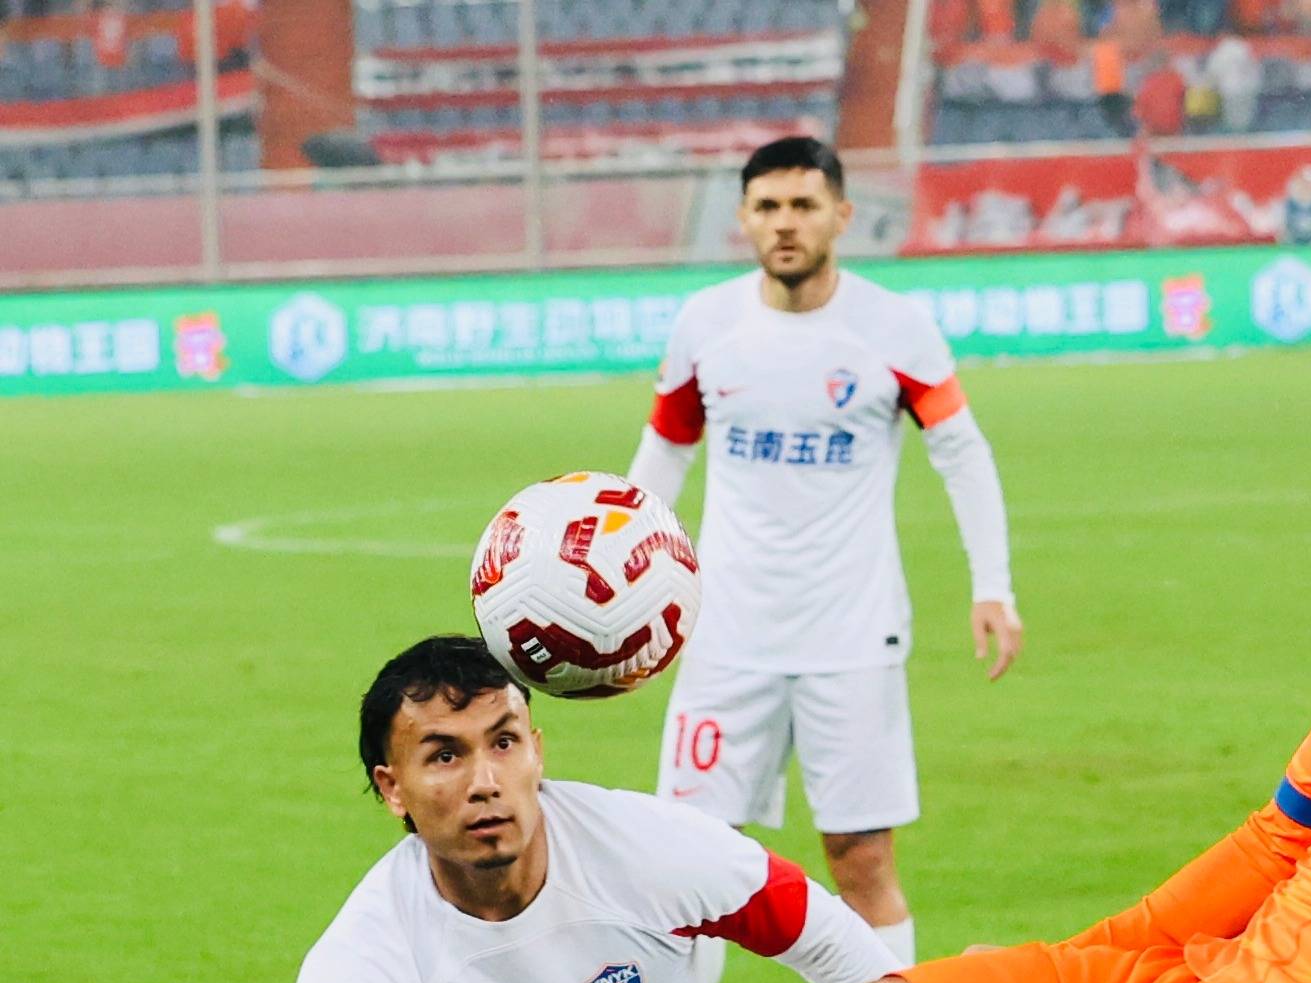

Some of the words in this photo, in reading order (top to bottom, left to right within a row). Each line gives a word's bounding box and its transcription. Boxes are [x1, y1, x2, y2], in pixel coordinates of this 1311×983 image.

[727, 426, 855, 464] 云南玉昆
[674, 712, 721, 773] 10
